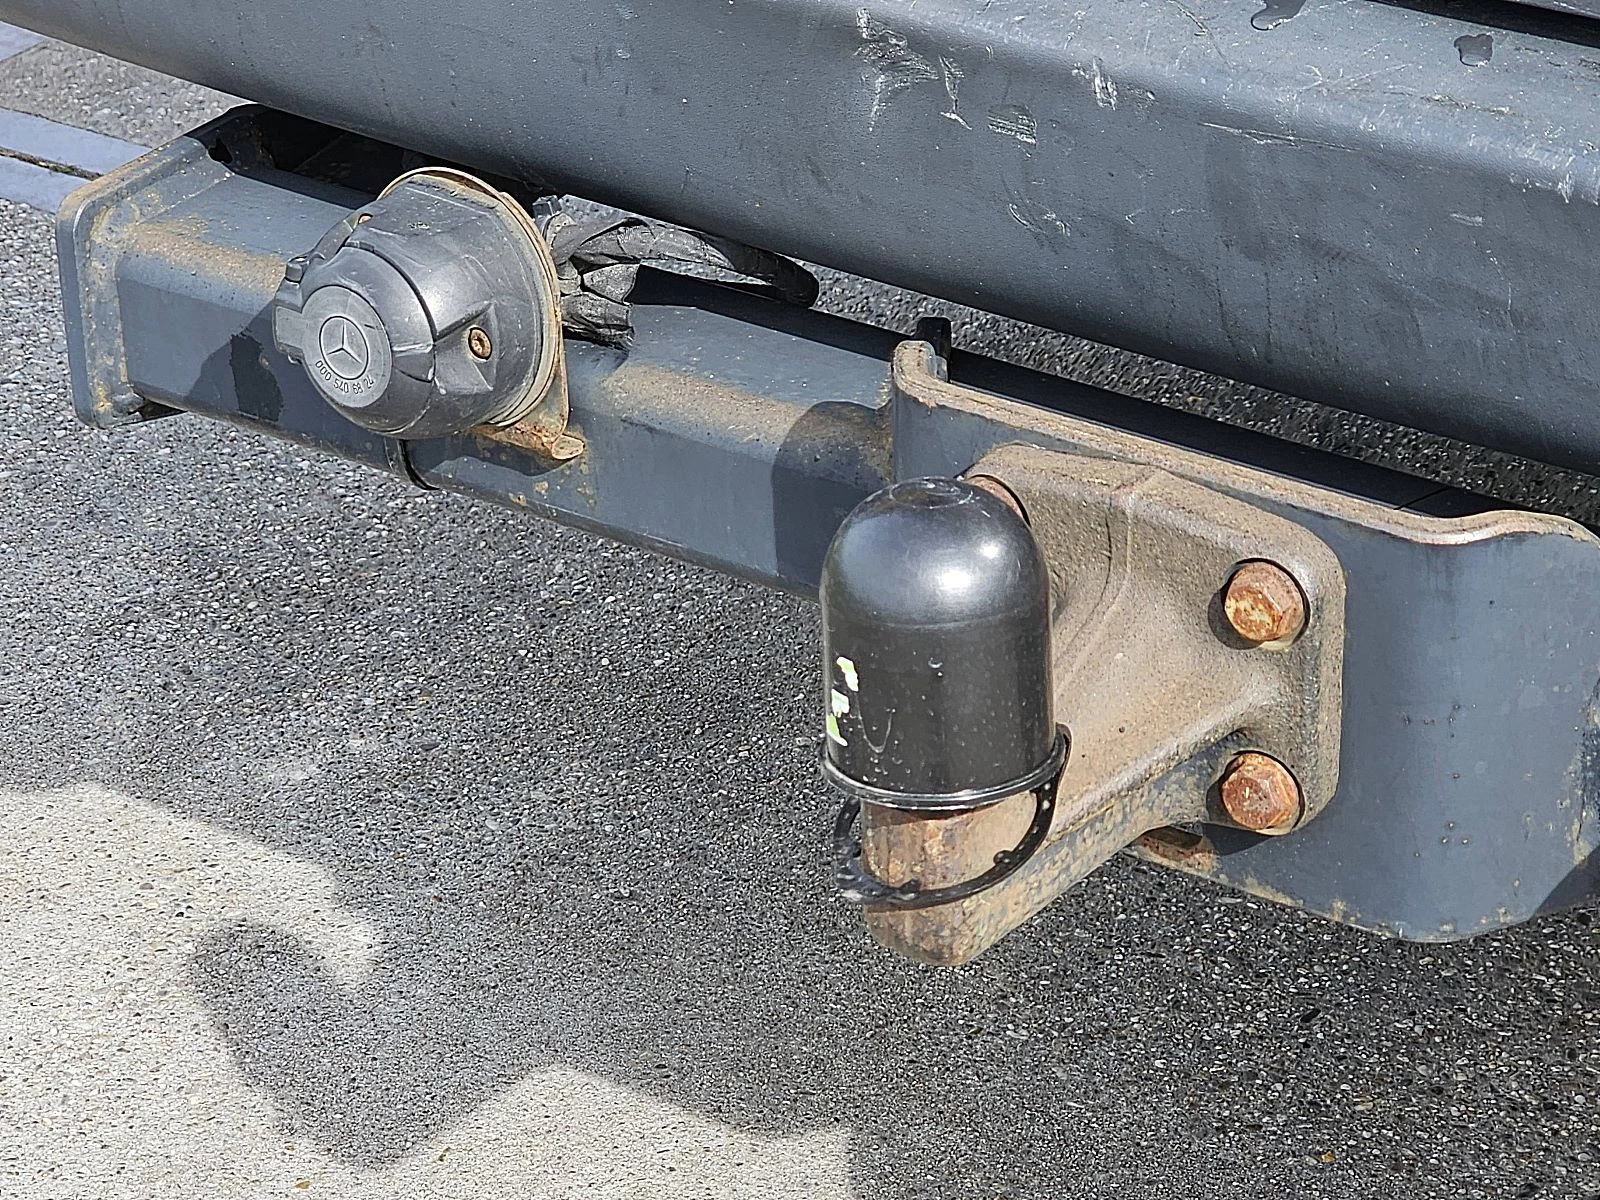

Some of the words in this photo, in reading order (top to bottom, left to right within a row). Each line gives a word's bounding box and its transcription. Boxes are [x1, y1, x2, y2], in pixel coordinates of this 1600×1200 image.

[315, 360, 332, 381] 000
[333, 378, 350, 394] 540
[363, 374, 375, 390] 24
